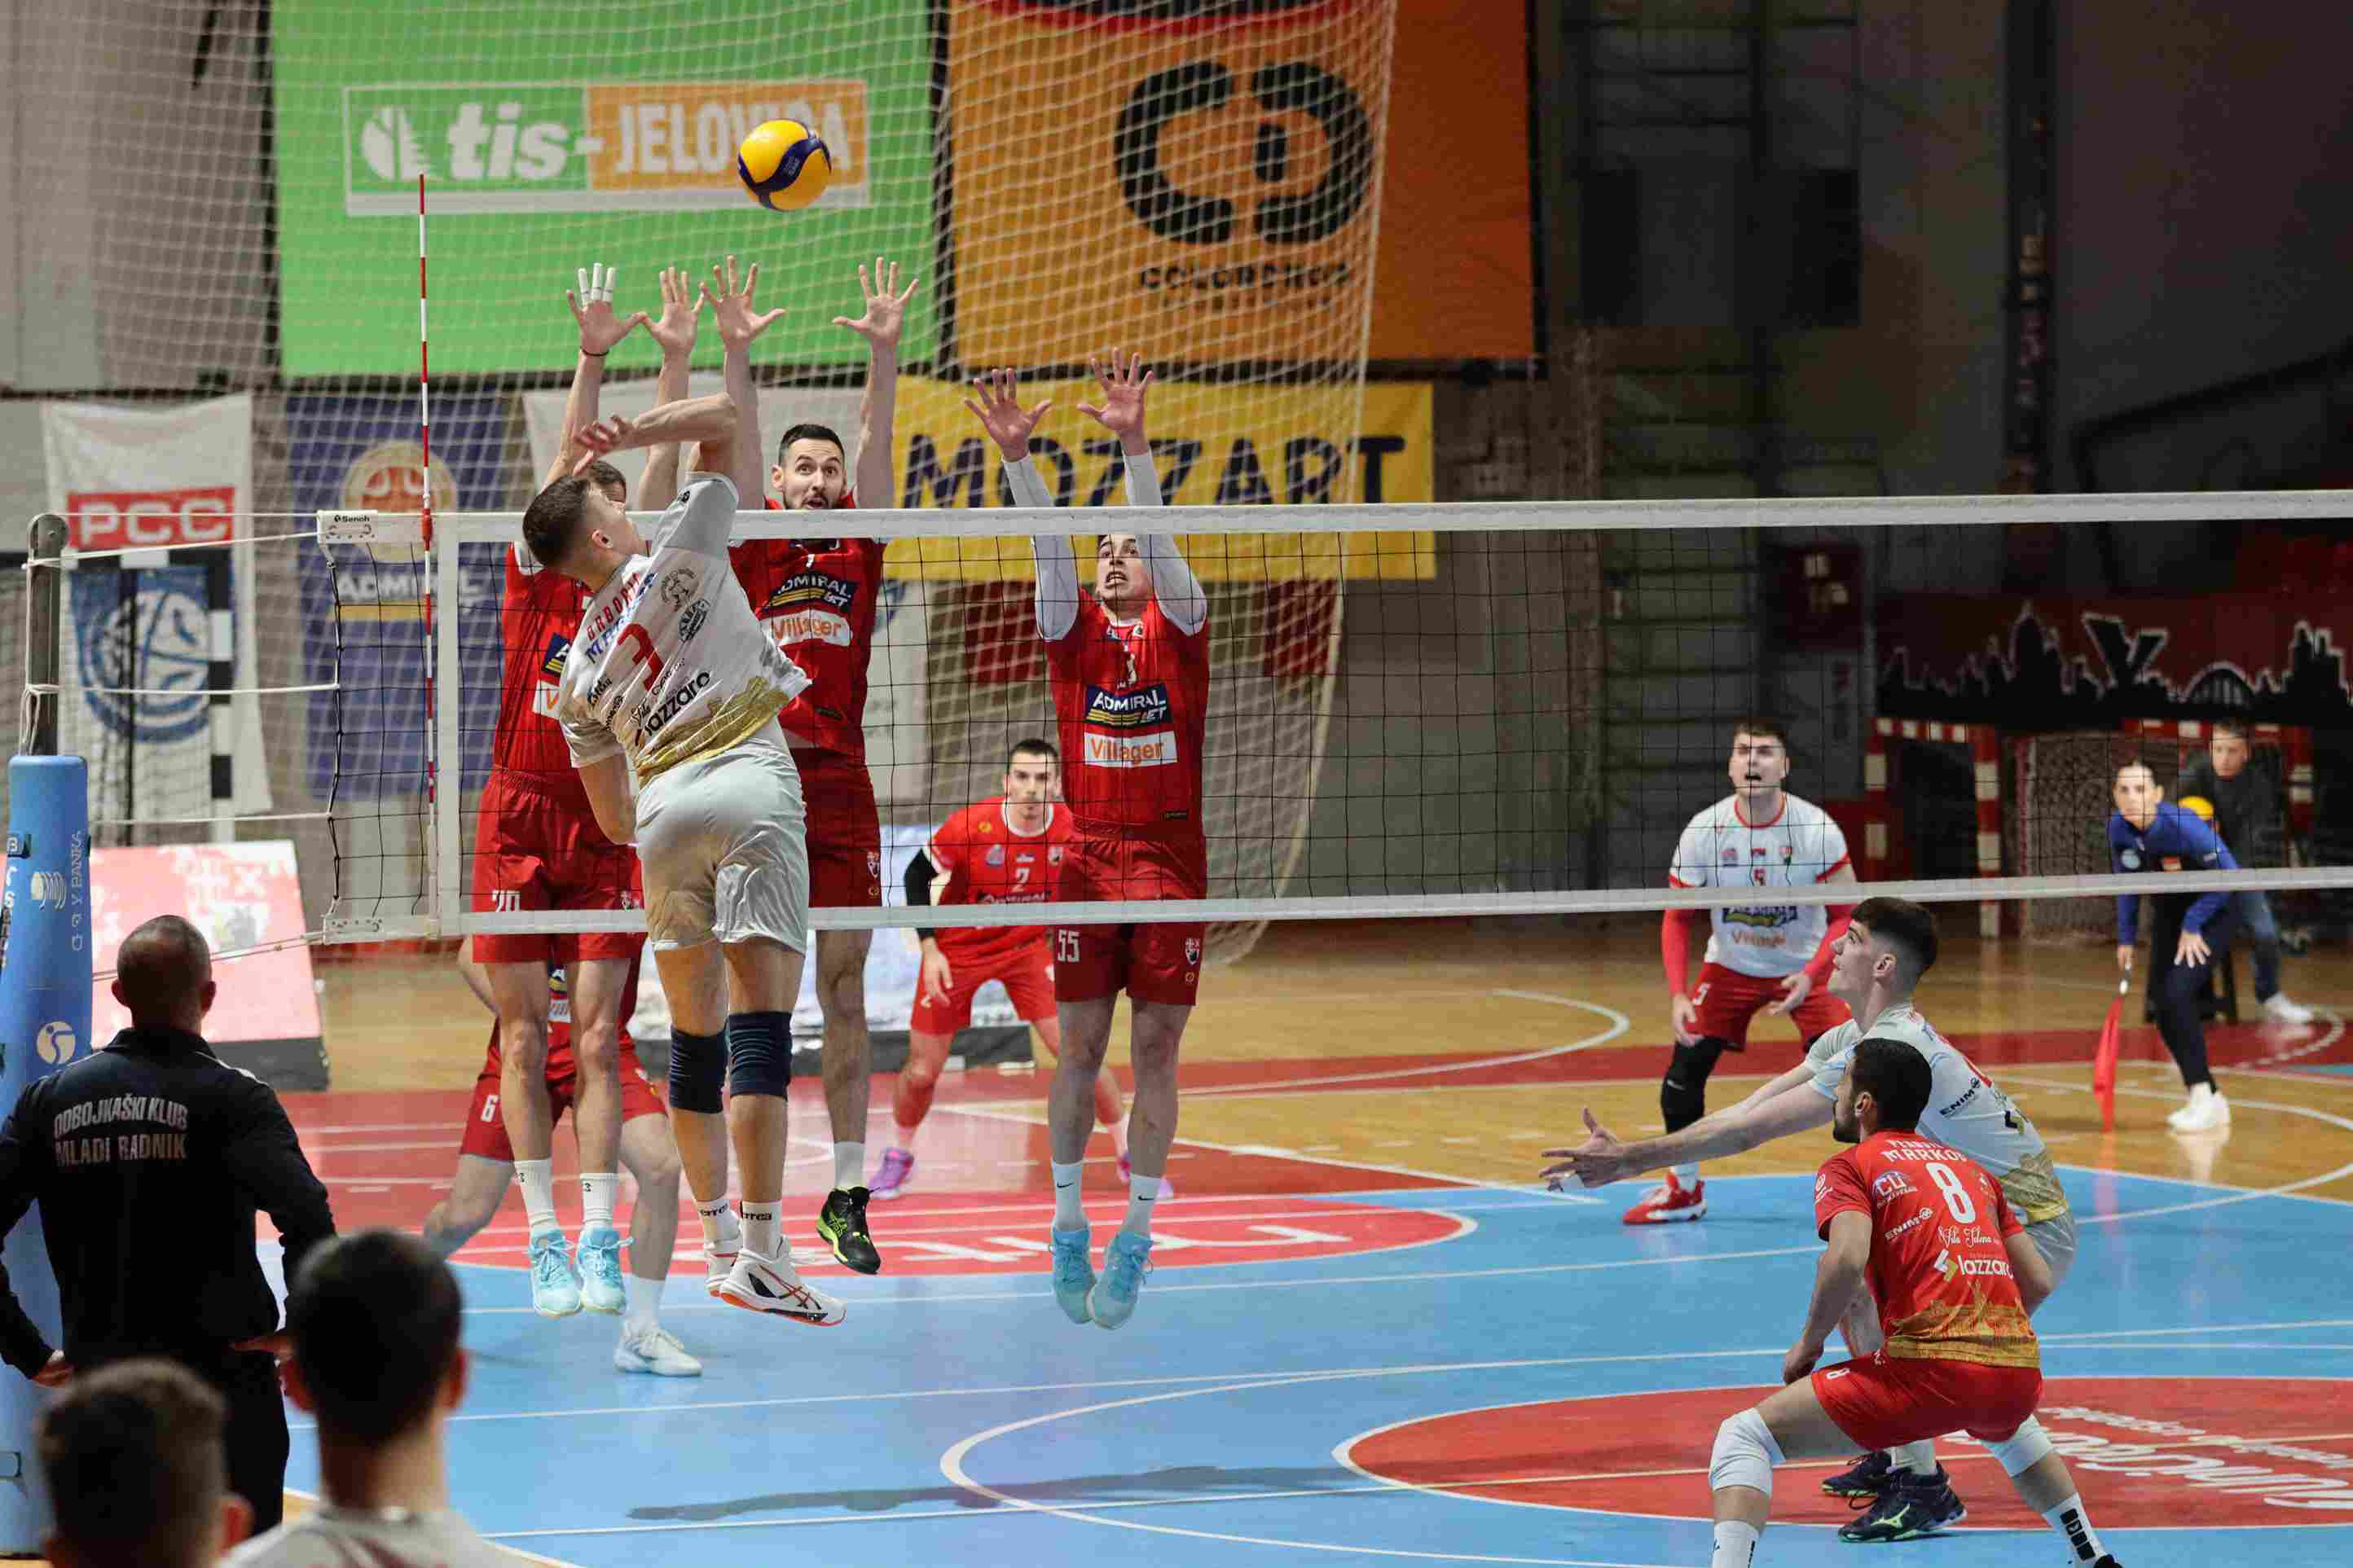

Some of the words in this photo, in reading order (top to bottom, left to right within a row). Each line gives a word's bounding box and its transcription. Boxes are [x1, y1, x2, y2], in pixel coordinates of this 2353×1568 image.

[78, 498, 230, 546] PCC
[1092, 691, 1167, 711] ADMIRAL
[1090, 738, 1163, 764] Villager
[1058, 929, 1080, 962] 55
[54, 1092, 147, 1139] ODBOJKAŠKI
[147, 1097, 188, 1130] KLUB
[481, 1094, 499, 1122] 6
[55, 1138, 110, 1166] MLADI
[117, 1133, 186, 1160] RADNIK
[1925, 1162, 1976, 1223] 8
